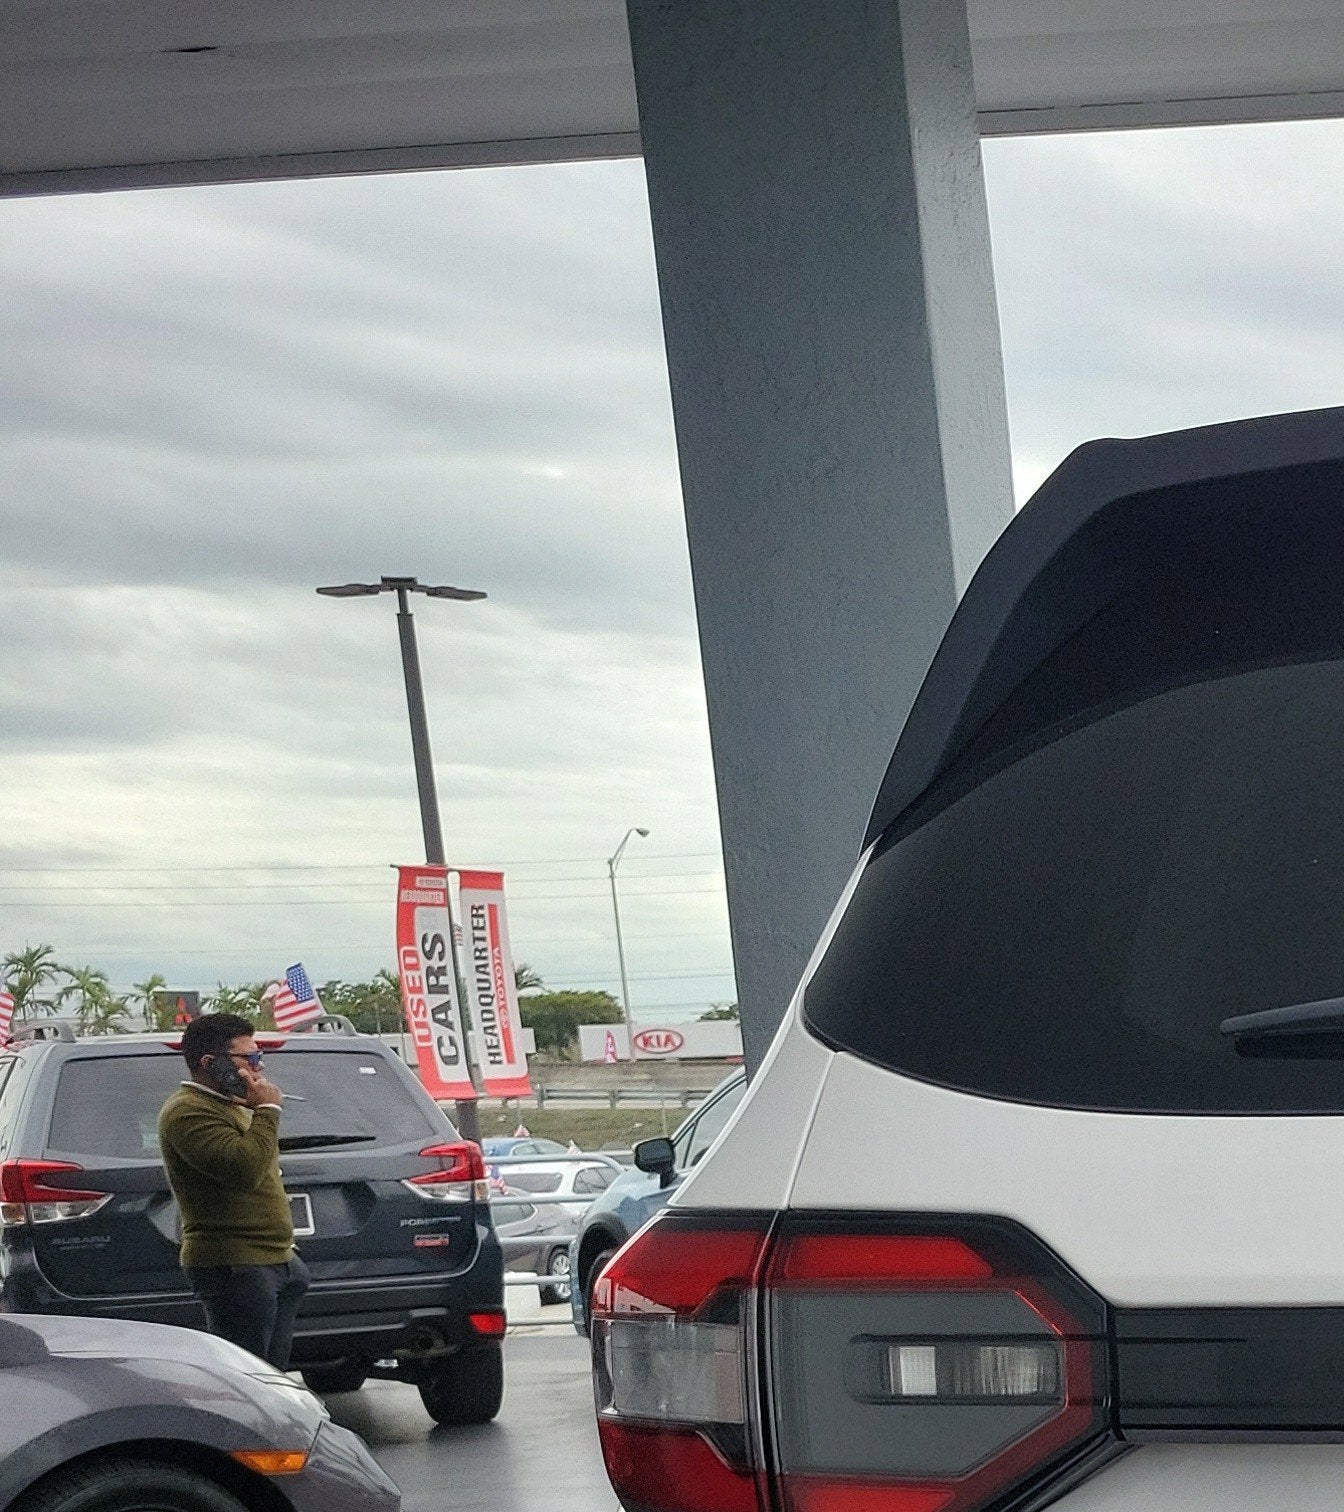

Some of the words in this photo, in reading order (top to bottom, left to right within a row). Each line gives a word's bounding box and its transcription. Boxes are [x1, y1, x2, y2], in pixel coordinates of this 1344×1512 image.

[401, 946, 432, 1047] USED
[421, 932, 459, 1066] CARS
[471, 904, 504, 1066] HEADQUARTER
[493, 947, 505, 1004] TOYOTA
[642, 1033, 676, 1049] KIA
